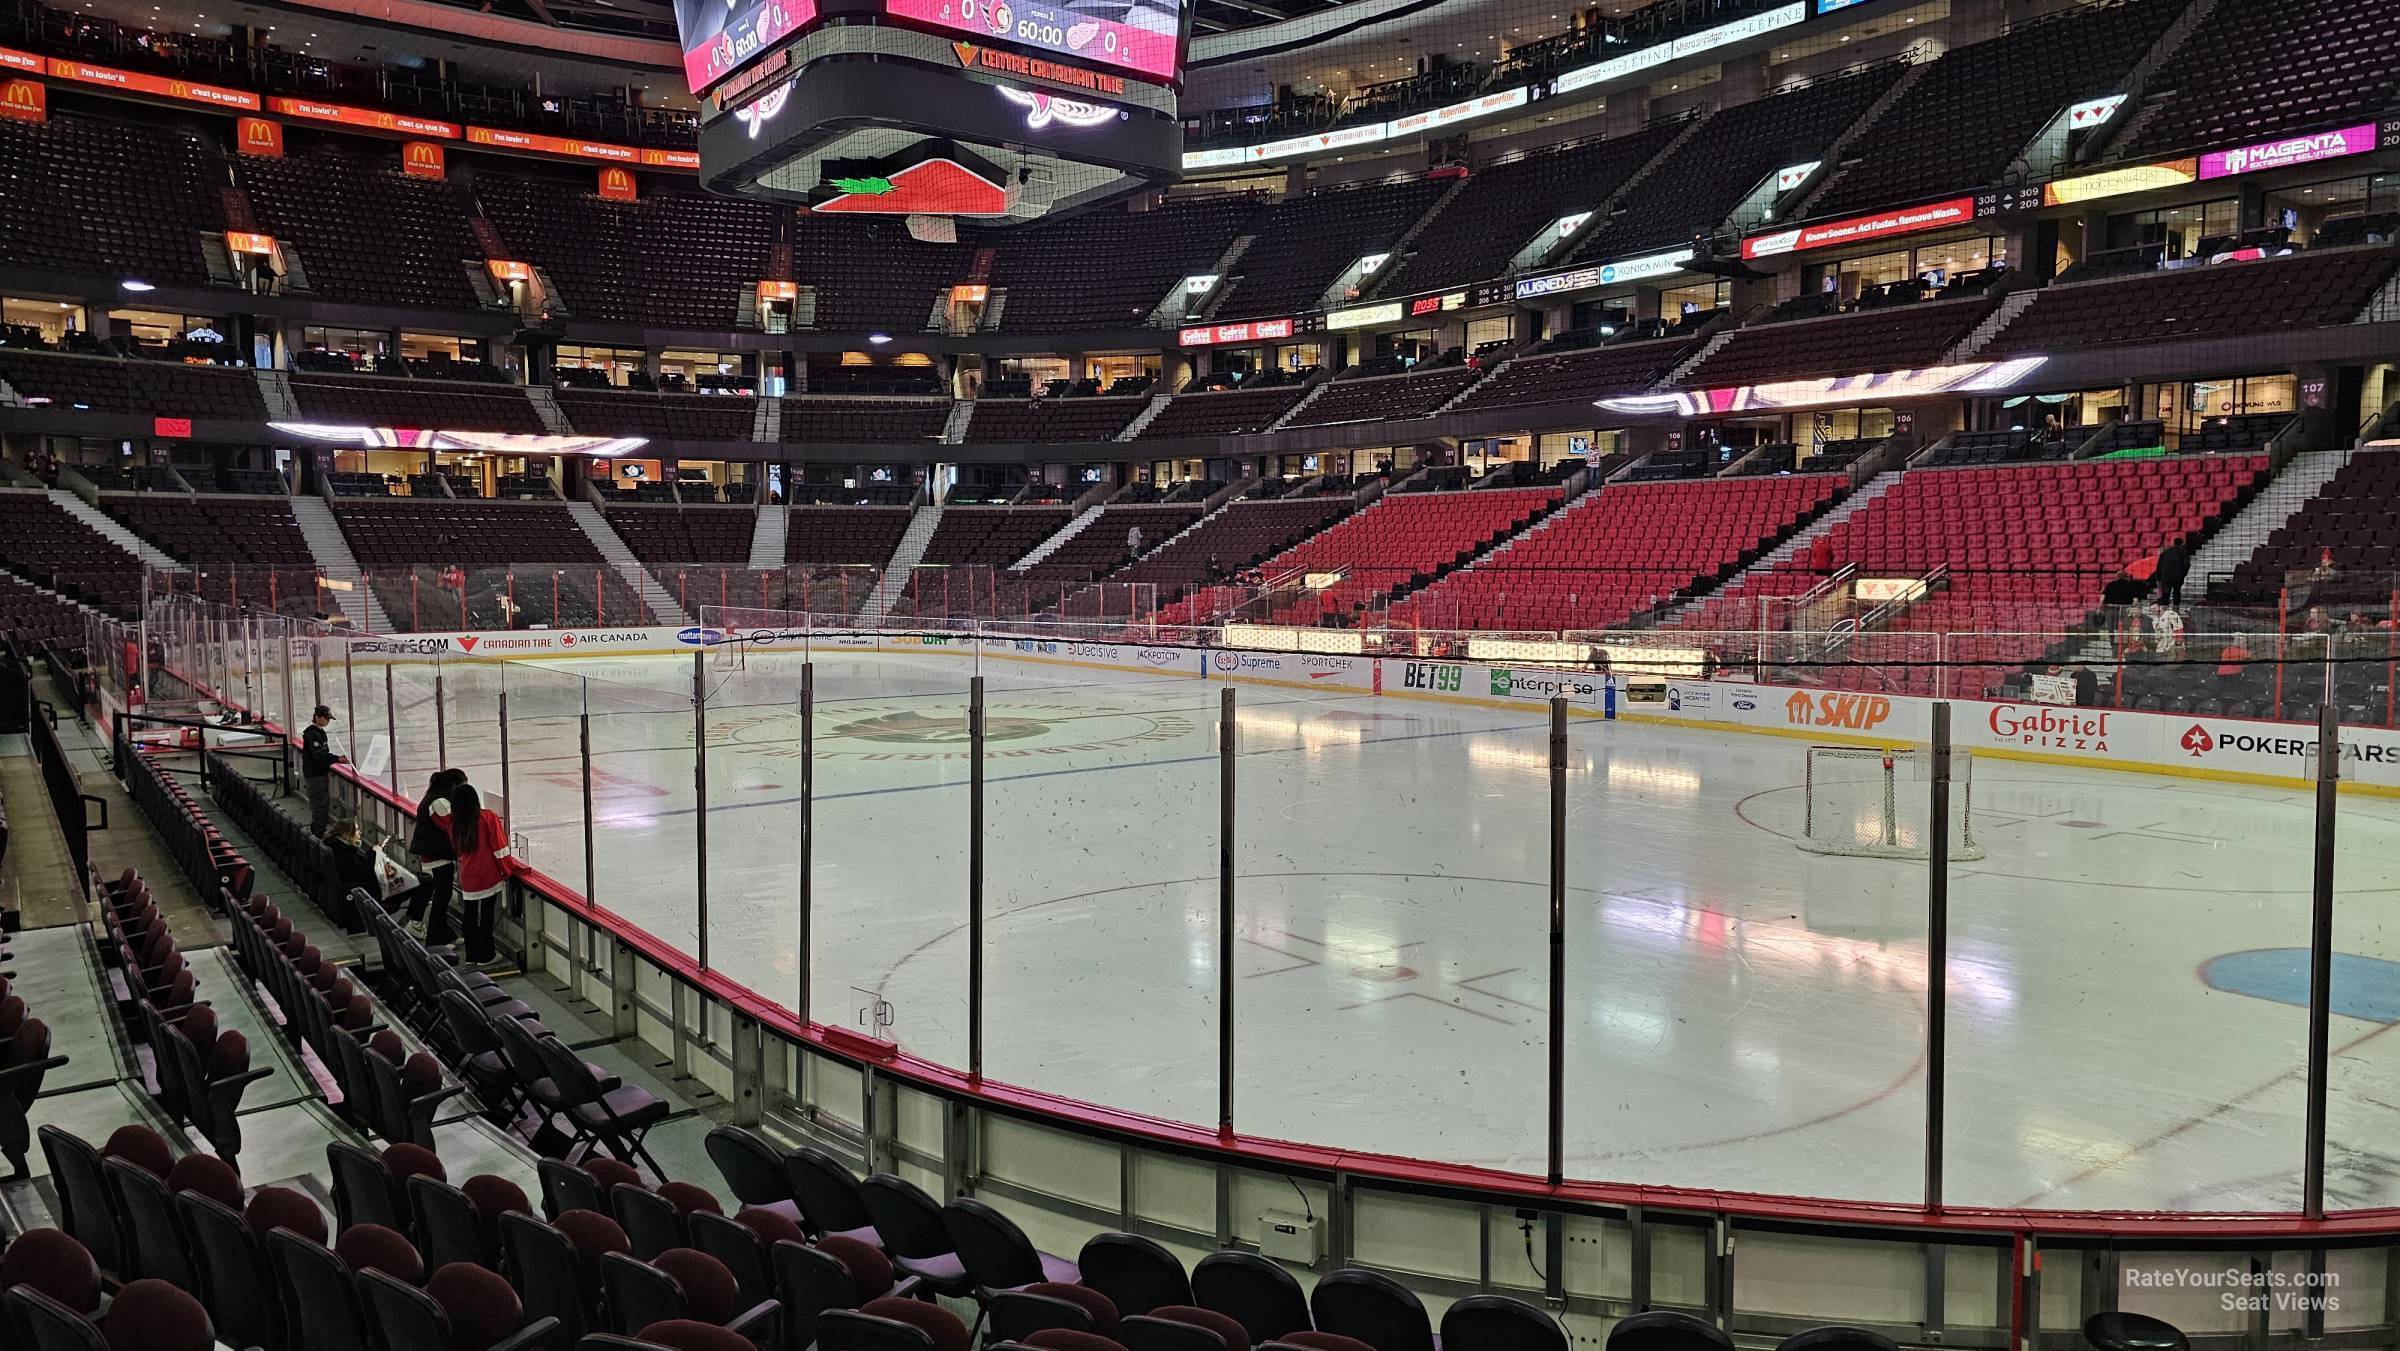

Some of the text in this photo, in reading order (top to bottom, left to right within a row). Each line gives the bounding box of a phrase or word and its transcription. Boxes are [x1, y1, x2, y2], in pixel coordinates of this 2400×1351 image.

[773, 4, 782, 27] 0
[944, 4, 950, 14] 0
[961, 0, 974, 19] 0
[1049, 11, 1055, 20] 1
[1748, 8, 1802, 32] LÉPINE
[1018, 19, 1062, 46] 60:00
[735, 30, 757, 57] 60:00
[1104, 32, 1116, 53] 0
[712, 46, 720, 67] 0
[1122, 46, 1128, 56] 0
[1622, 46, 1670, 71] LÉPINE
[81, 68, 94, 77] I'm
[96, 70, 118, 81] lovin'
[981, 49, 1124, 94] CENTRE CANADIAN TIRE
[192, 88, 211, 98] c'est
[1481, 92, 1516, 108] Hyperline
[299, 104, 310, 113] I'm
[312, 106, 331, 115] lovin'
[1438, 103, 1470, 119] Hyperline
[1332, 128, 1378, 142] CANADIAN TIRE
[2383, 122, 2400, 132] 30
[495, 133, 505, 141] I'm
[506, 134, 524, 143] lovin'
[2250, 132, 2346, 160] MAGENTA
[2383, 135, 2400, 146] 20
[1266, 143, 1296, 154] CANADIAN
[667, 154, 677, 162] I'm
[678, 155, 694, 163] lovin'
[2250, 146, 2346, 170] EXTERIOR SOLUTIONS
[1978, 187, 2039, 205] 308 309
[1977, 199, 2039, 216] 208 209
[1805, 230, 1828, 242] Know
[1828, 226, 1858, 239] Sooner.
[1858, 222, 1871, 232] Act
[1872, 219, 1898, 231] Faster.
[1899, 213, 1932, 225] Remove
[1933, 208, 1961, 220] Waste.
[1618, 263, 1651, 276] KONICA
[1503, 284, 1514, 292] 307
[1518, 277, 1565, 296] ALIGNED
[1503, 292, 1514, 300] 207
[1416, 297, 1440, 313] ROSS
[1183, 328, 1210, 342] Gabriel
[1219, 326, 1248, 340] Gabriel
[1256, 322, 1286, 335] Gabriel
[2303, 384, 2324, 392] 107
[1896, 415, 1912, 423] 106
[483, 638, 552, 648] CANADIAN TIRE
[579, 632, 648, 643] AIR CANADA
[1078, 642, 1117, 658] Decisive
[1137, 649, 1180, 661] JACKPOTCITY
[1241, 655, 1280, 670] Supreme
[1404, 663, 1462, 692] BET99
[1498, 676, 1593, 695] enterprise
[1815, 692, 1891, 730] SKIP
[1989, 705, 2111, 737] Gabriel
[2024, 734, 2108, 752] PIZZA
[2219, 734, 2400, 764] POKERSARS
